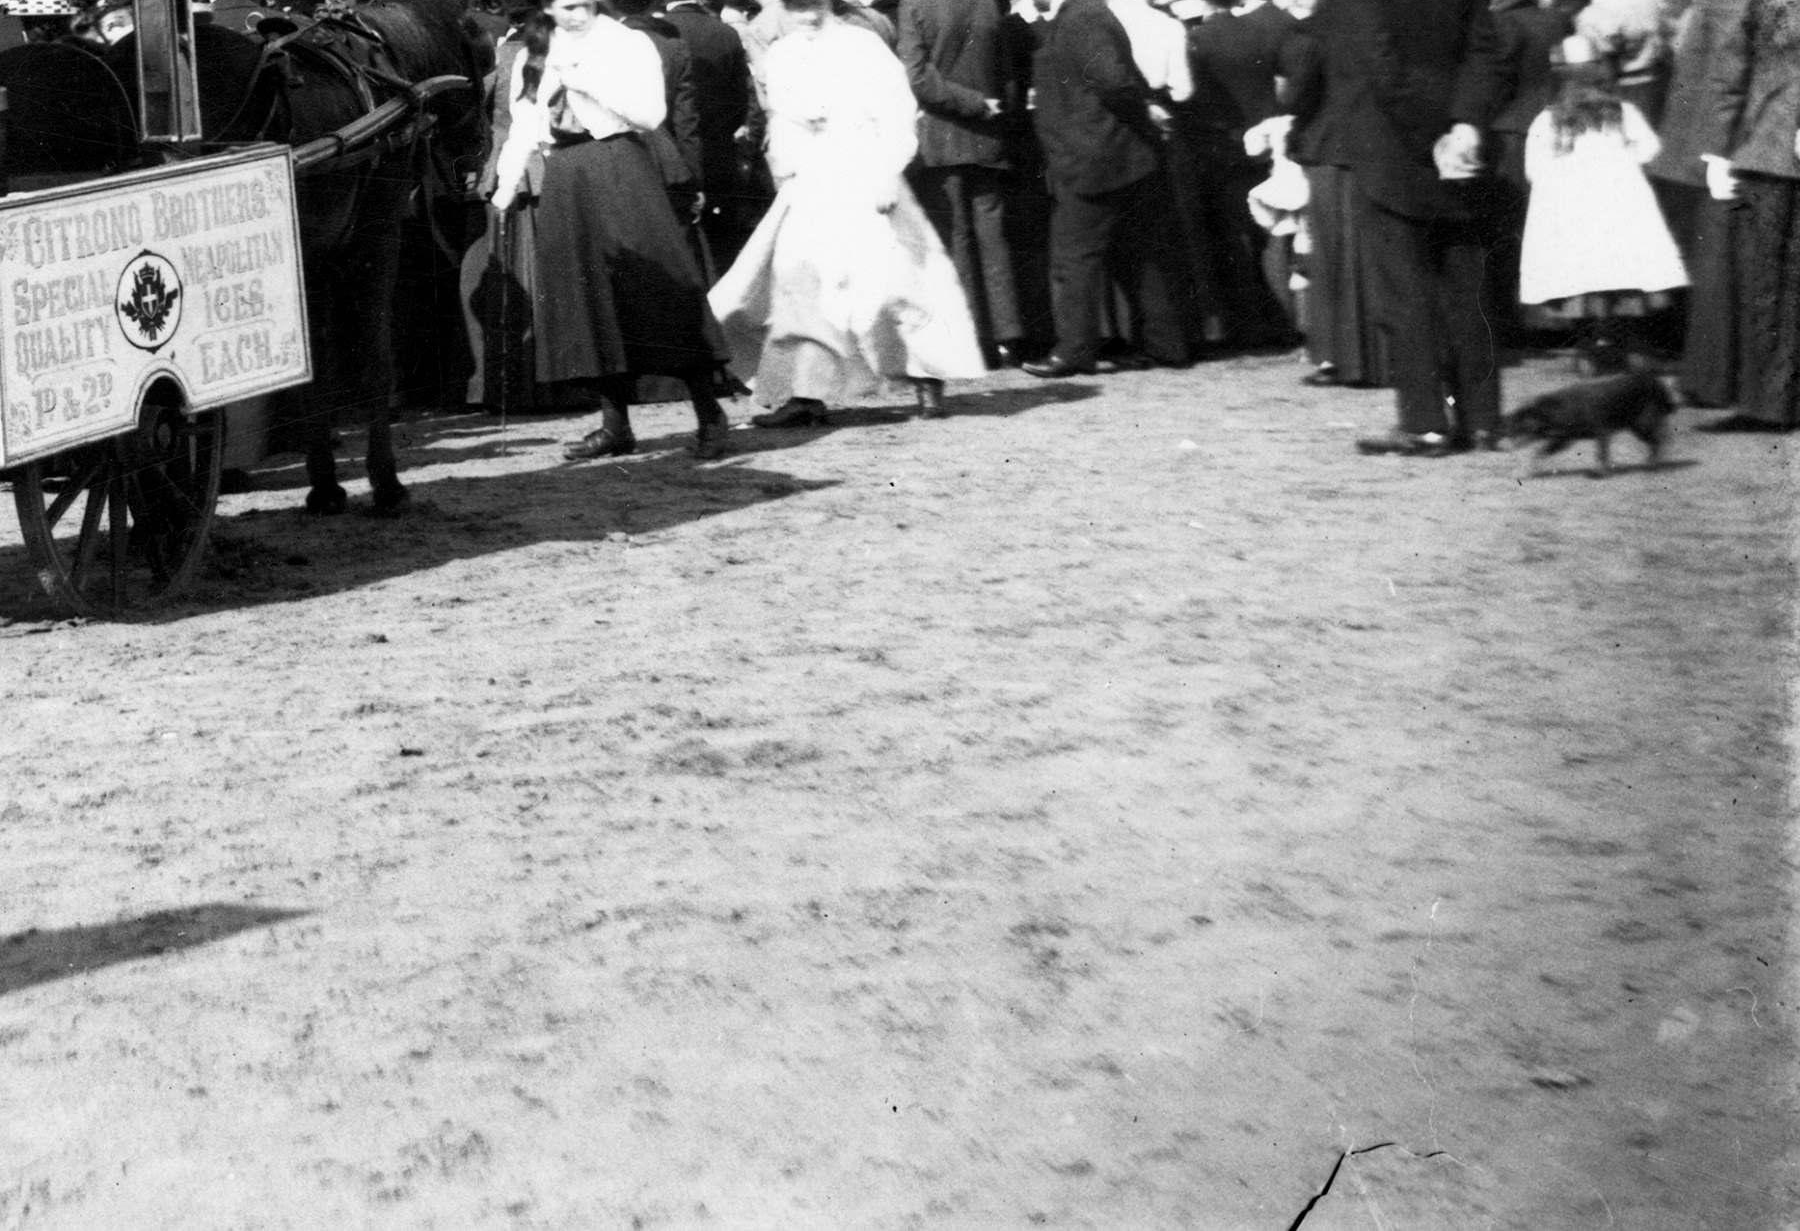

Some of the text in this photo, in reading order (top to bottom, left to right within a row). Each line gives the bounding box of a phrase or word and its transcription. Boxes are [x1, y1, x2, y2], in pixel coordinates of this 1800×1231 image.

[11, 228, 285, 326] SPECIAL NEAPOLITAN
[13, 313, 113, 378] QUALITY
